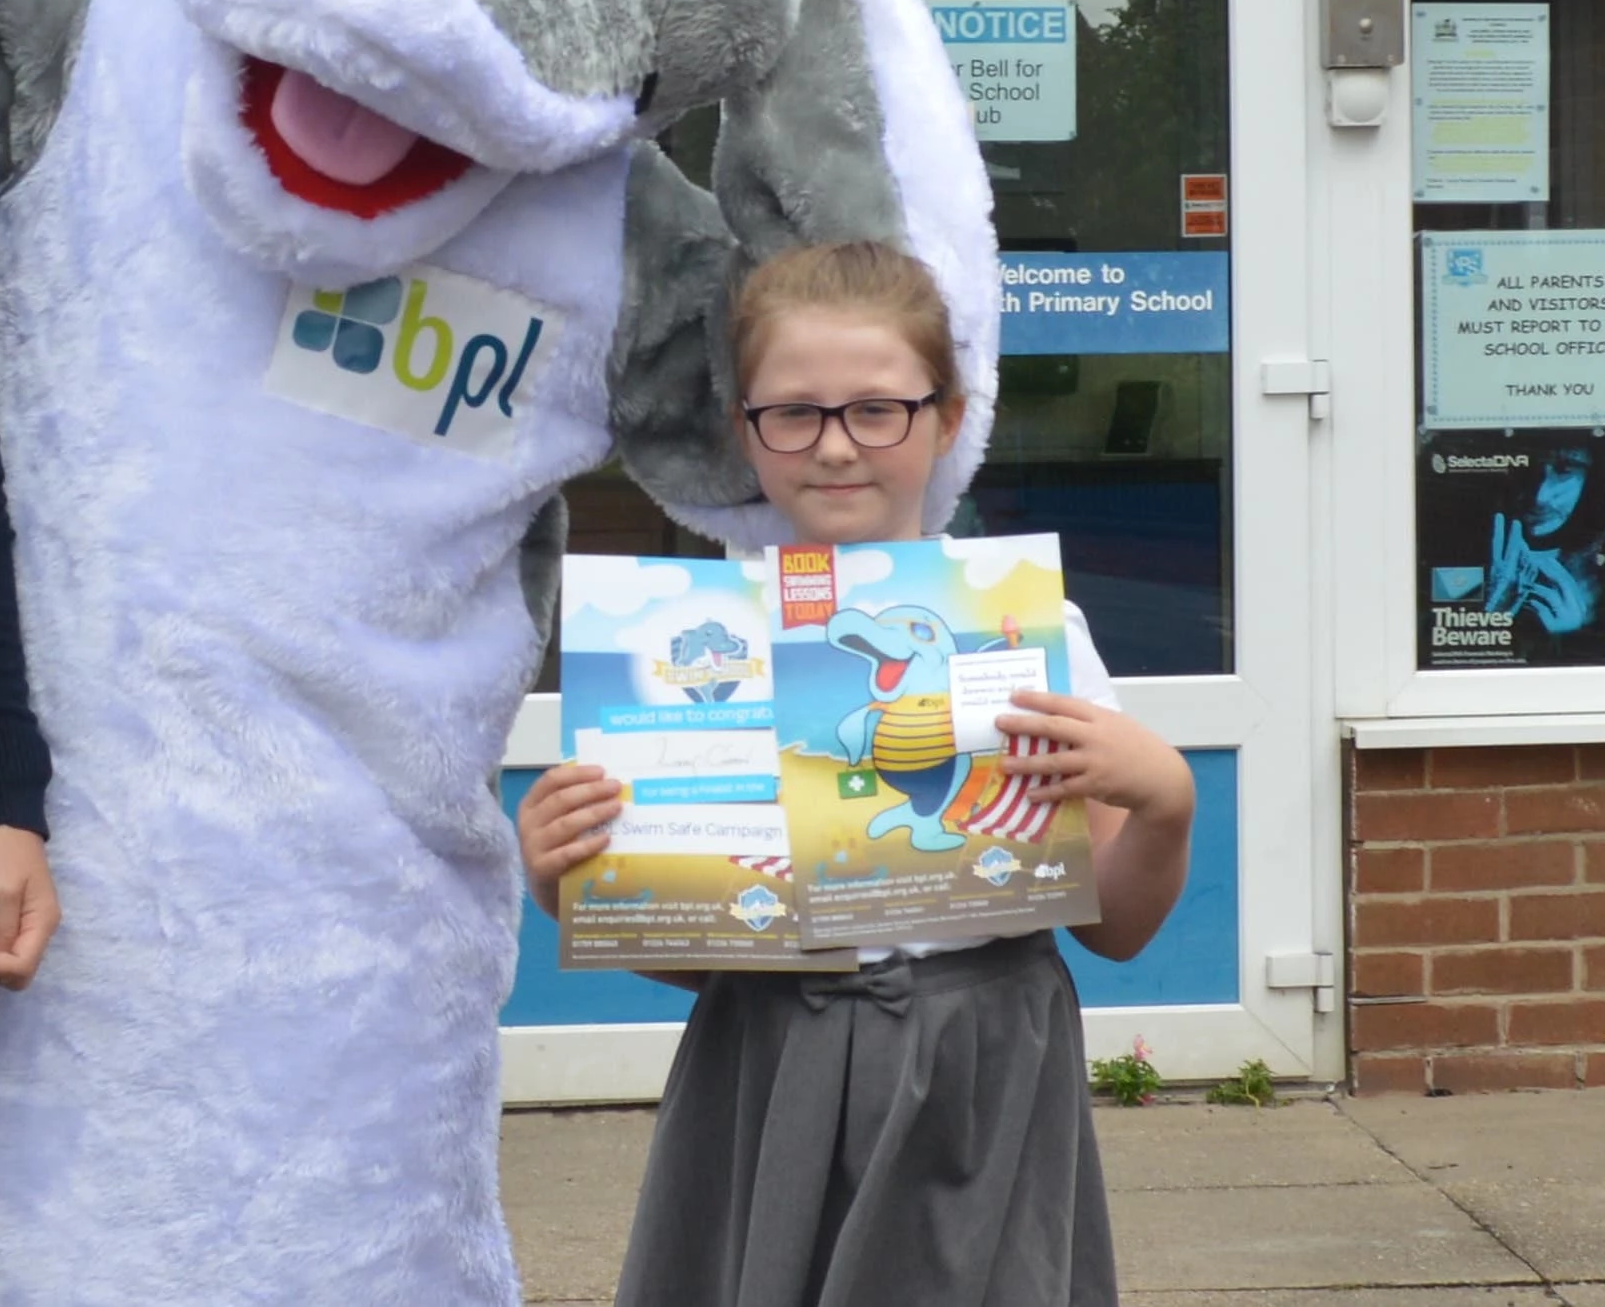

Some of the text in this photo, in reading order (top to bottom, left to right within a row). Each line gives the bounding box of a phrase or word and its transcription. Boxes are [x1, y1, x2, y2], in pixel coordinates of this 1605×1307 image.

[934, 10, 1064, 39] NOTICE
[971, 59, 1009, 78] Bell
[1015, 59, 1043, 78] for
[969, 82, 1040, 101] School
[976, 106, 1001, 124] ub
[1101, 263, 1126, 284] to
[1497, 275, 1605, 289] ALL PARENTS
[1029, 292, 1120, 316] Primary
[1130, 290, 1213, 312] School
[1488, 298, 1523, 312] AND
[1457, 321, 1504, 334] MUST
[1511, 320, 1572, 334] REPORT
[1579, 319, 1602, 333] TO
[391, 277, 544, 437] bpl
[1484, 342, 1549, 356] SCHOOL
[1505, 383, 1595, 397] THANK YOU
[1448, 455, 1529, 468] SelectaDNA
[783, 553, 831, 573] BOOK
[784, 587, 833, 602] LESSONS
[785, 601, 835, 622] TODAY
[1432, 607, 1514, 627] Thieves
[1432, 627, 1512, 646] Beware
[609, 710, 656, 726] would
[658, 708, 684, 724] like
[686, 708, 705, 724] to
[622, 821, 665, 837] Swim
[668, 822, 701, 837] Safe
[705, 823, 783, 841] Campaign
